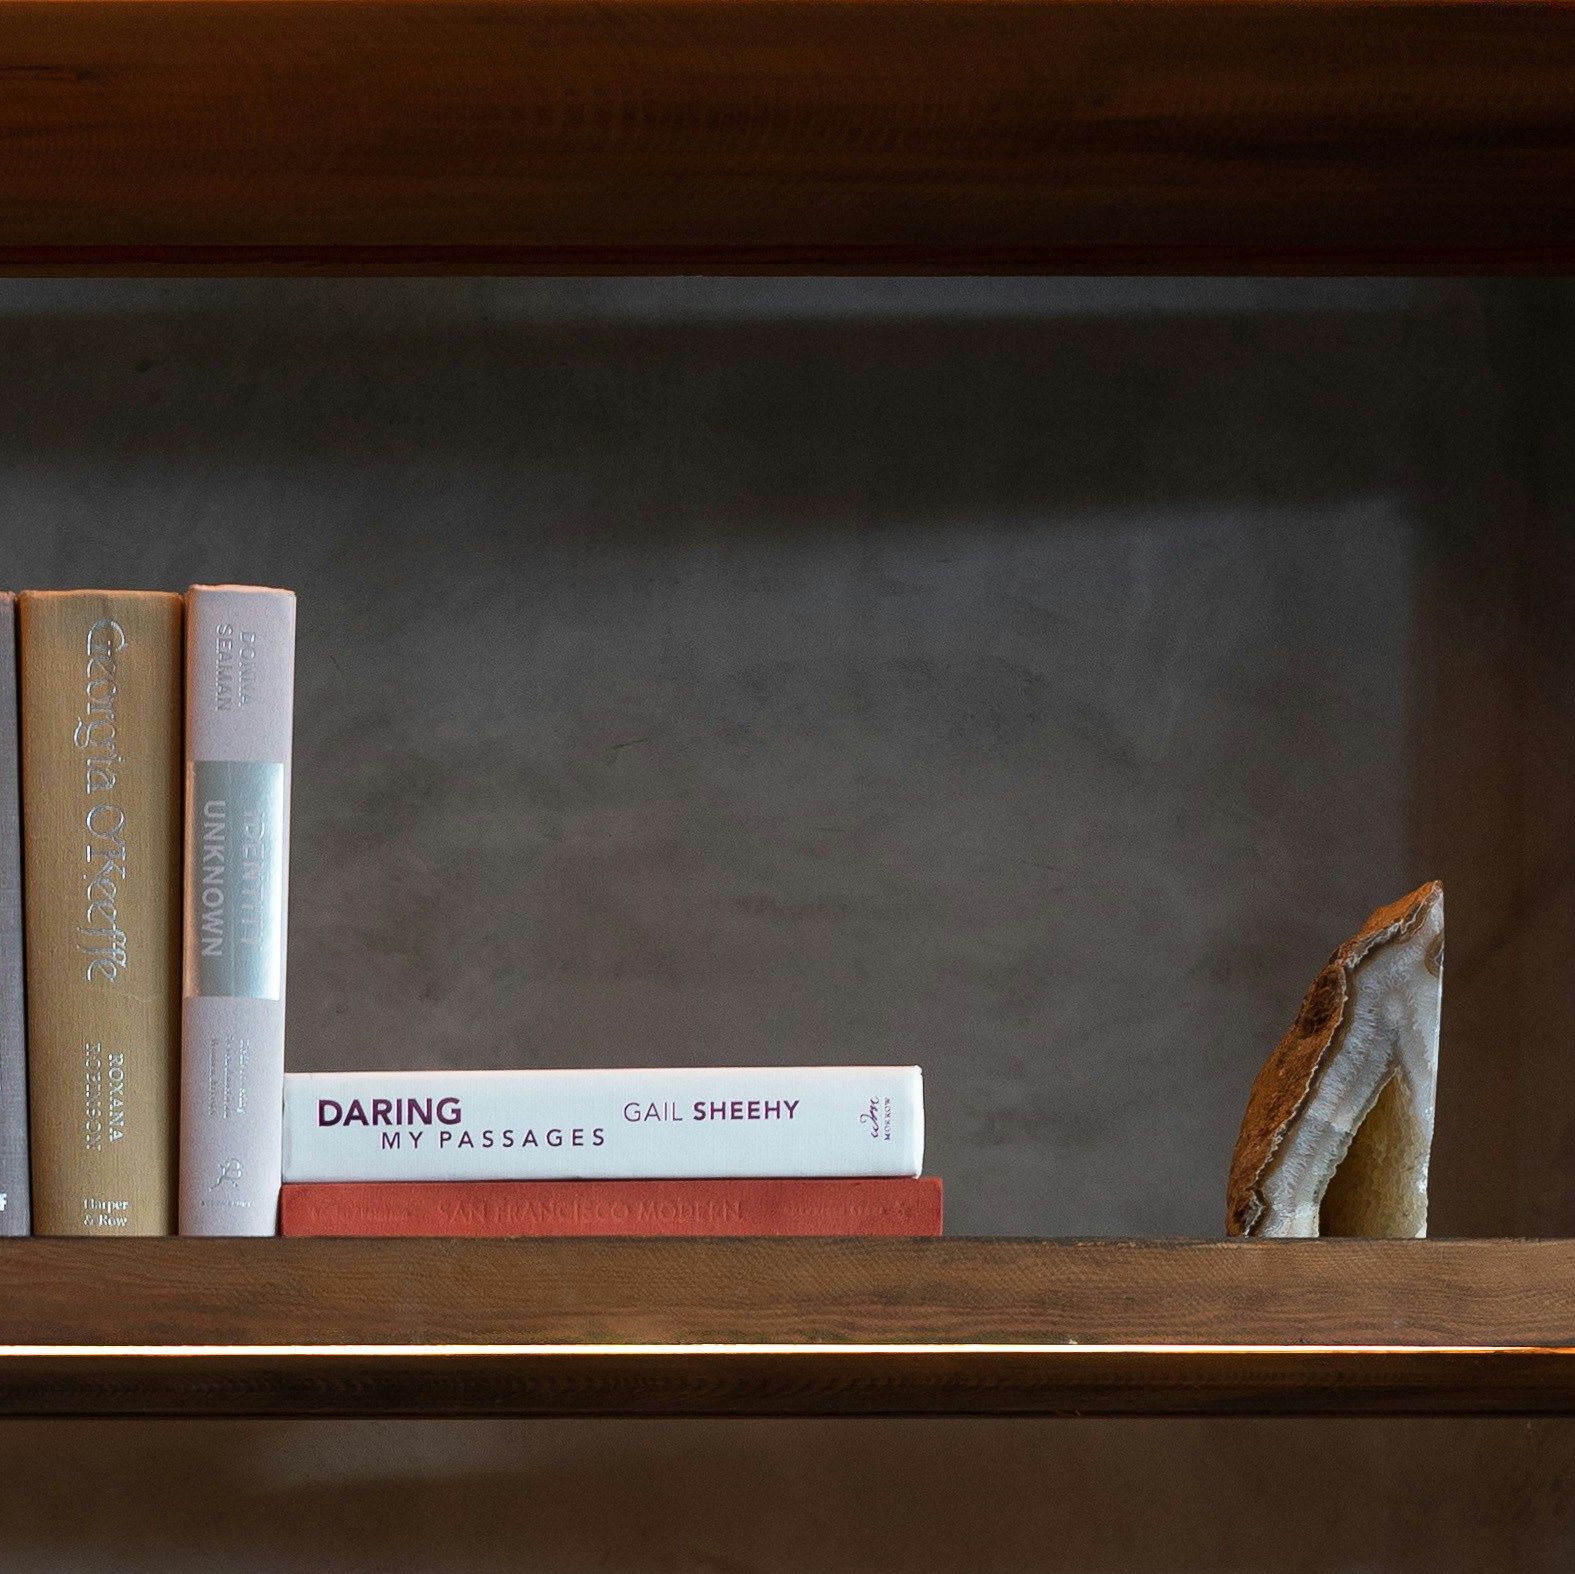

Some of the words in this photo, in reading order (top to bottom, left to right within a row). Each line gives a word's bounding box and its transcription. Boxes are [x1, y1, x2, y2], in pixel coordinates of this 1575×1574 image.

[74, 619, 128, 795] Georgia
[201, 800, 226, 957] UNKNOWN
[85, 1041, 102, 1152] ROBINSON
[108, 1053, 125, 1142] ROXANA
[317, 1097, 462, 1127] DARING
[623, 1102, 683, 1122] GAIL
[692, 1100, 800, 1121] SHEEHY
[381, 1131, 423, 1149] MY
[439, 1128, 605, 1149] PASSAGES
